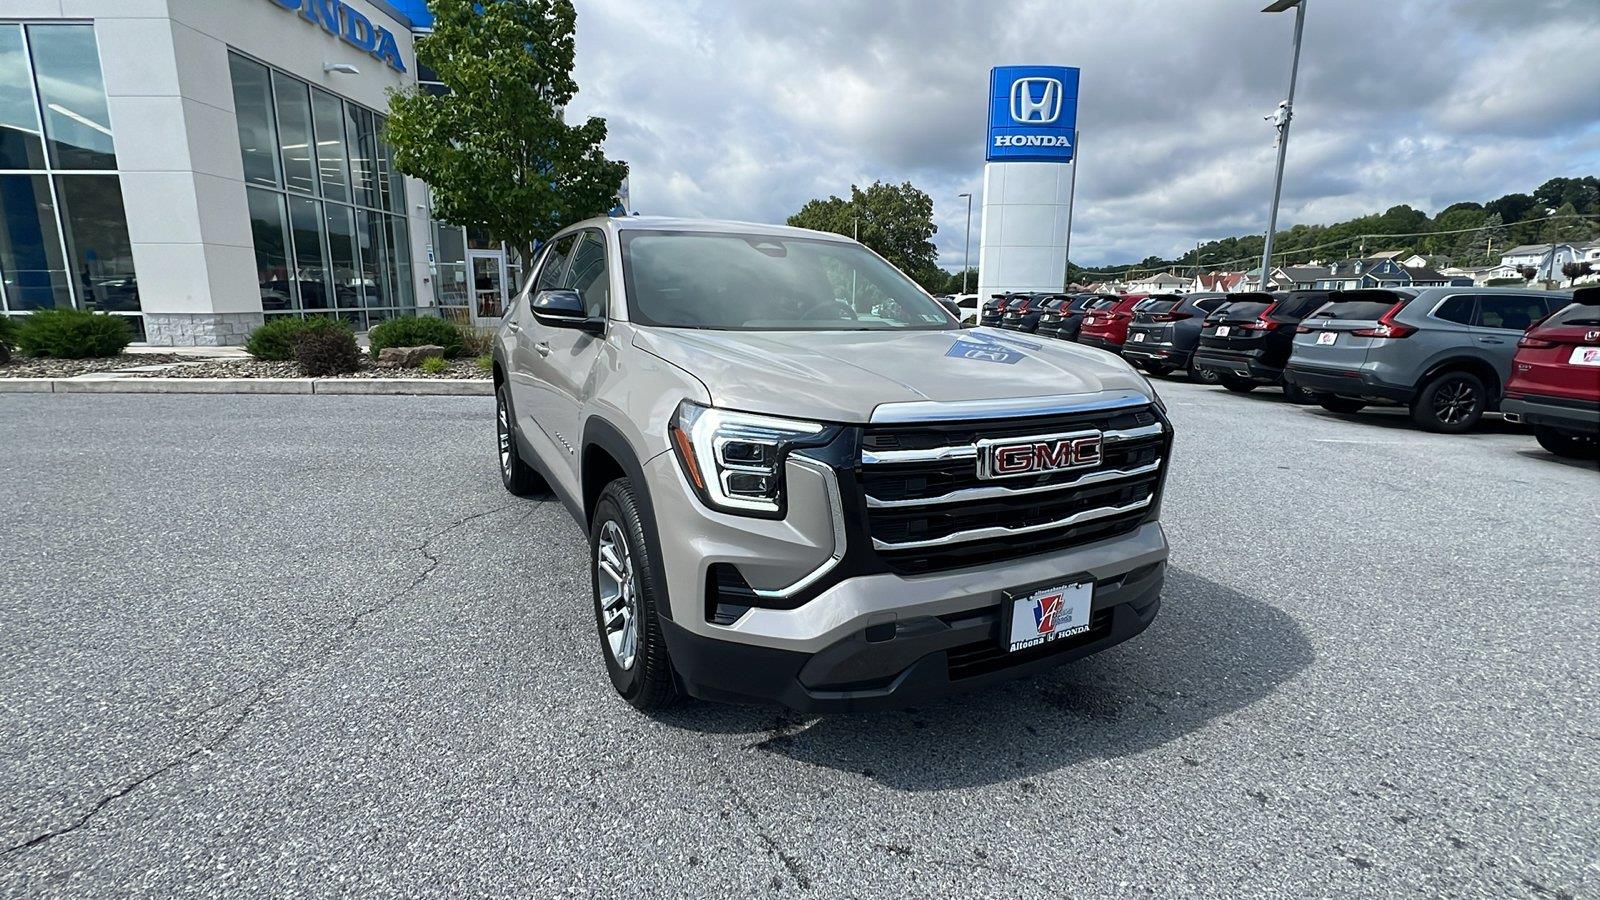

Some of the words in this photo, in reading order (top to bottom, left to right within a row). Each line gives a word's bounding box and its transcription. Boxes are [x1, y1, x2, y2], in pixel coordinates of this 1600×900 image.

[268, 0, 407, 73] NDA
[994, 135, 1071, 147] HONDA
[995, 438, 1101, 473] GMC
[1009, 638, 1044, 652] Altoona
[1057, 625, 1090, 639] HONDA
